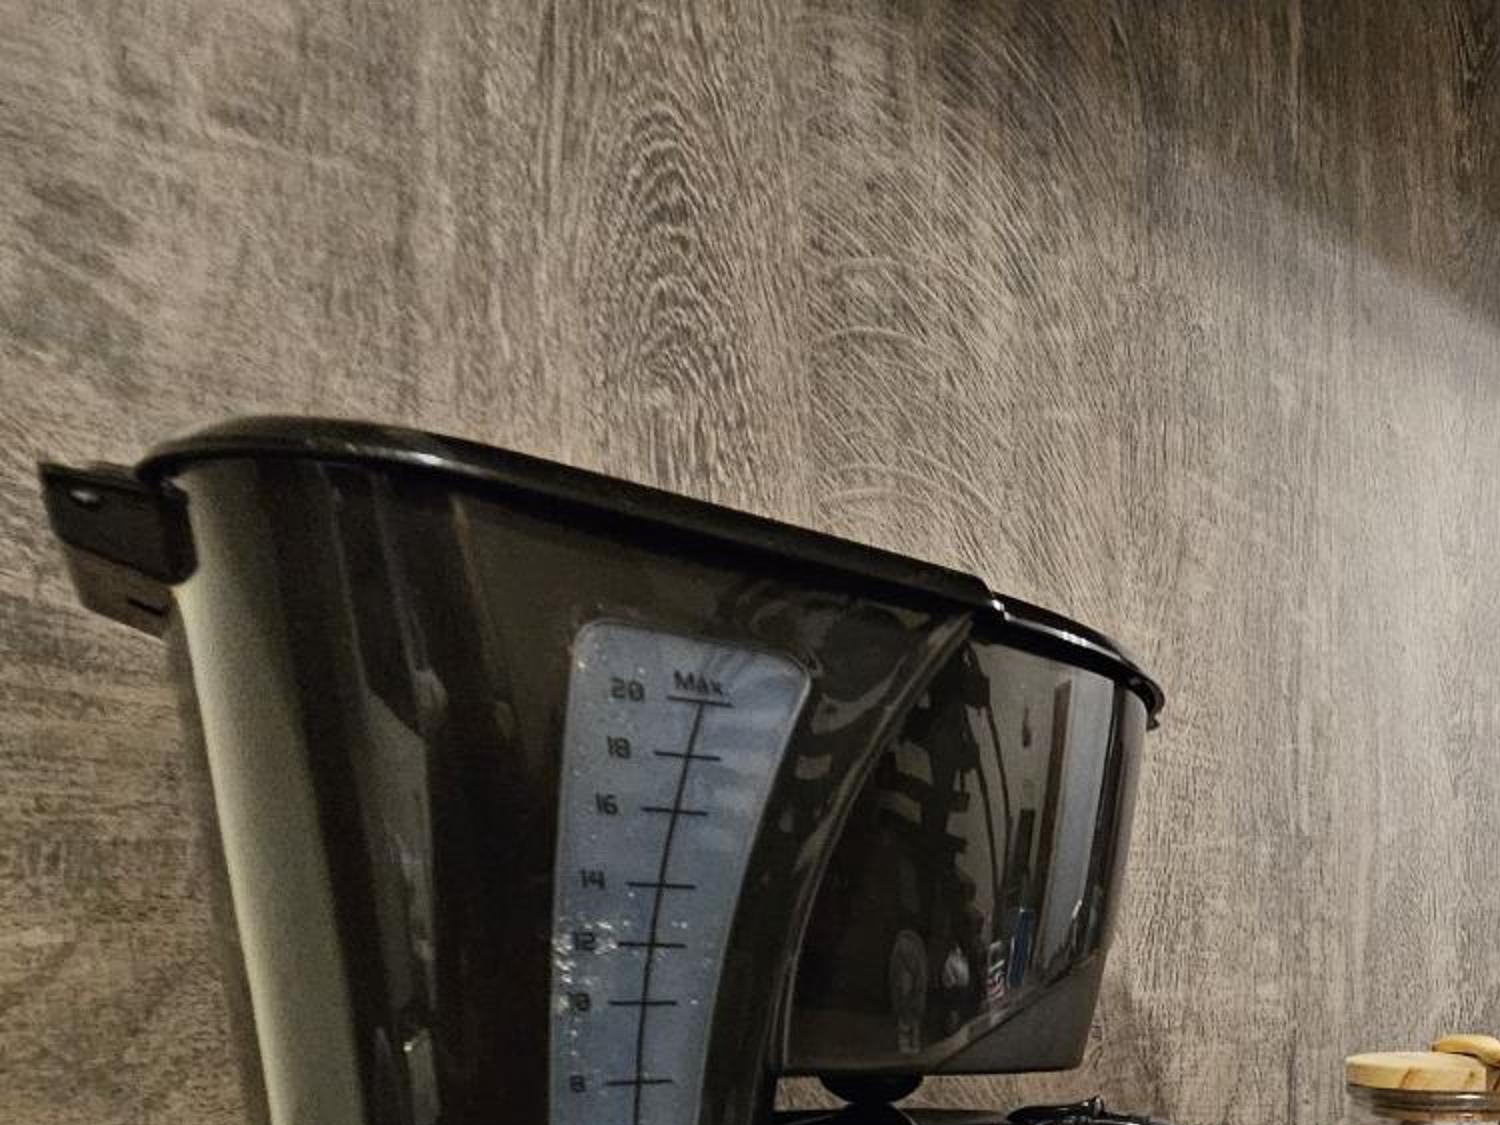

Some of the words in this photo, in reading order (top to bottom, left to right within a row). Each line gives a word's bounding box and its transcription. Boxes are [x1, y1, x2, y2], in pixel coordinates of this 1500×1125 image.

[611, 677, 645, 702] 20
[606, 736, 631, 759] 18
[595, 793, 618, 815] 16
[578, 869, 605, 889] 14
[573, 931, 597, 951] 12
[569, 1074, 586, 1093] 8
